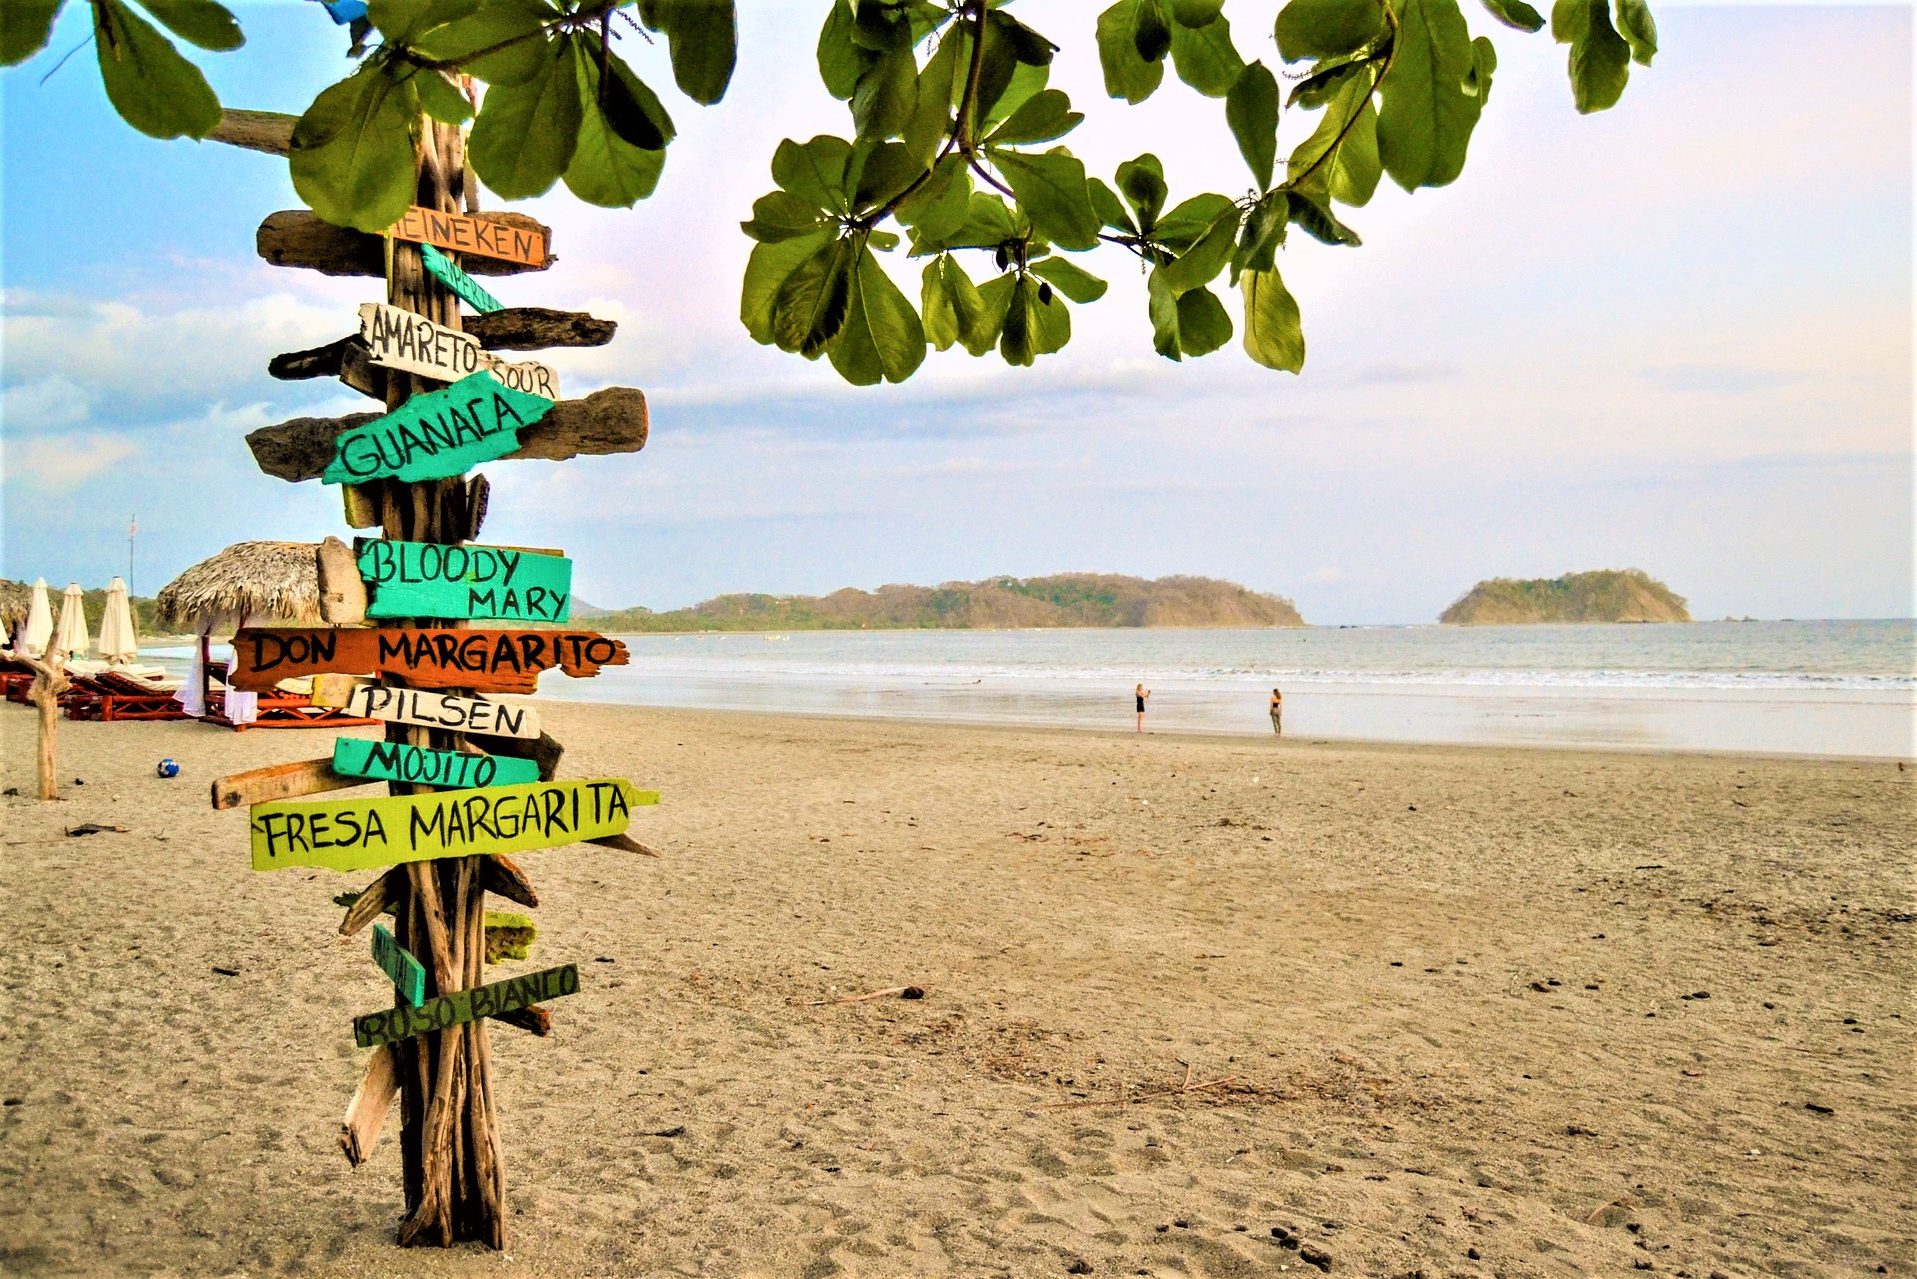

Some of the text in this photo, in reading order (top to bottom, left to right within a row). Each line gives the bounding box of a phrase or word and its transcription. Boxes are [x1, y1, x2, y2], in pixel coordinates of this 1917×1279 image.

[371, 304, 478, 374] AMARETO
[341, 392, 523, 476] GUANACA
[369, 541, 520, 586] BLOODY
[468, 587, 567, 620] MARY
[250, 631, 616, 674] DON MARGARITO
[363, 685, 524, 735] PILSEN
[362, 741, 496, 788] MOJITO
[258, 782, 630, 857] FRESA MARGARITA
[470, 964, 579, 1019] BIANCO
